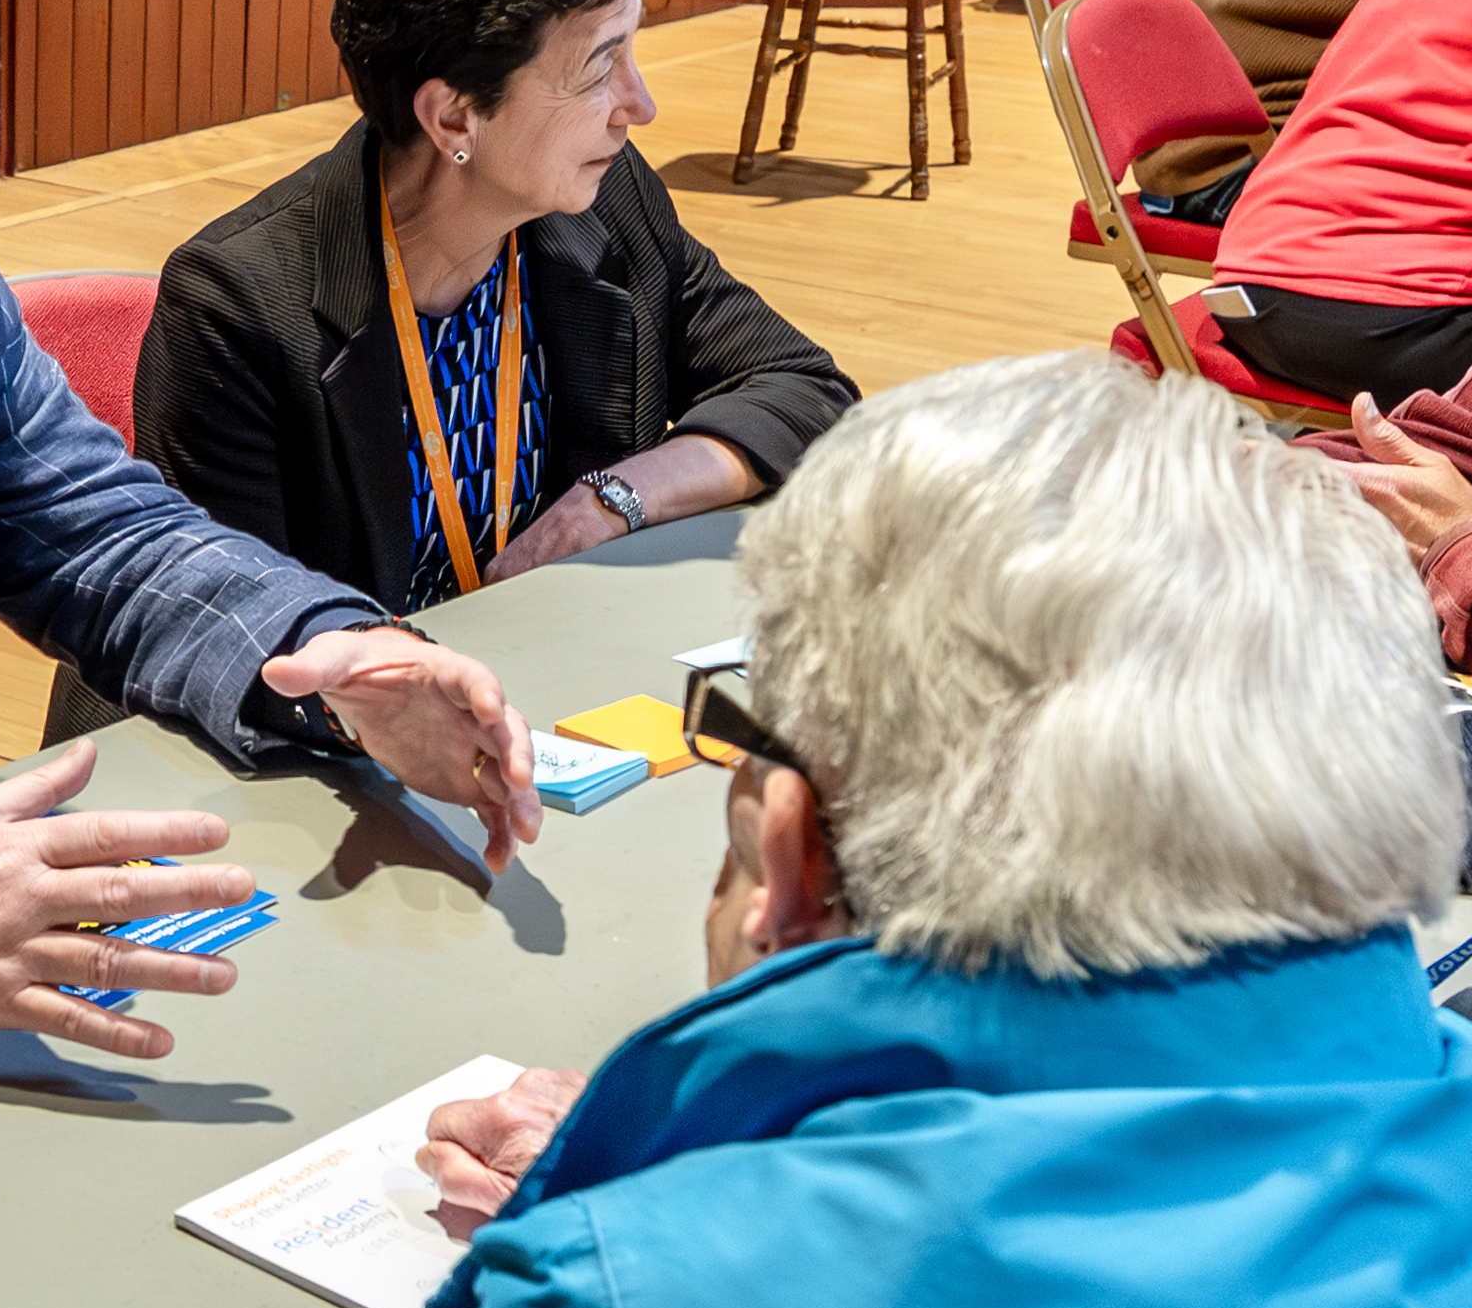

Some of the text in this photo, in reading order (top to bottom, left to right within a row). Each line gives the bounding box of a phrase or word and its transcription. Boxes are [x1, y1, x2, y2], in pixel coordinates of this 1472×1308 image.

[213, 1147, 353, 1221] Shaping Eastlight
[273, 1195, 381, 1254] Resident
[323, 1206, 399, 1250] Academy
